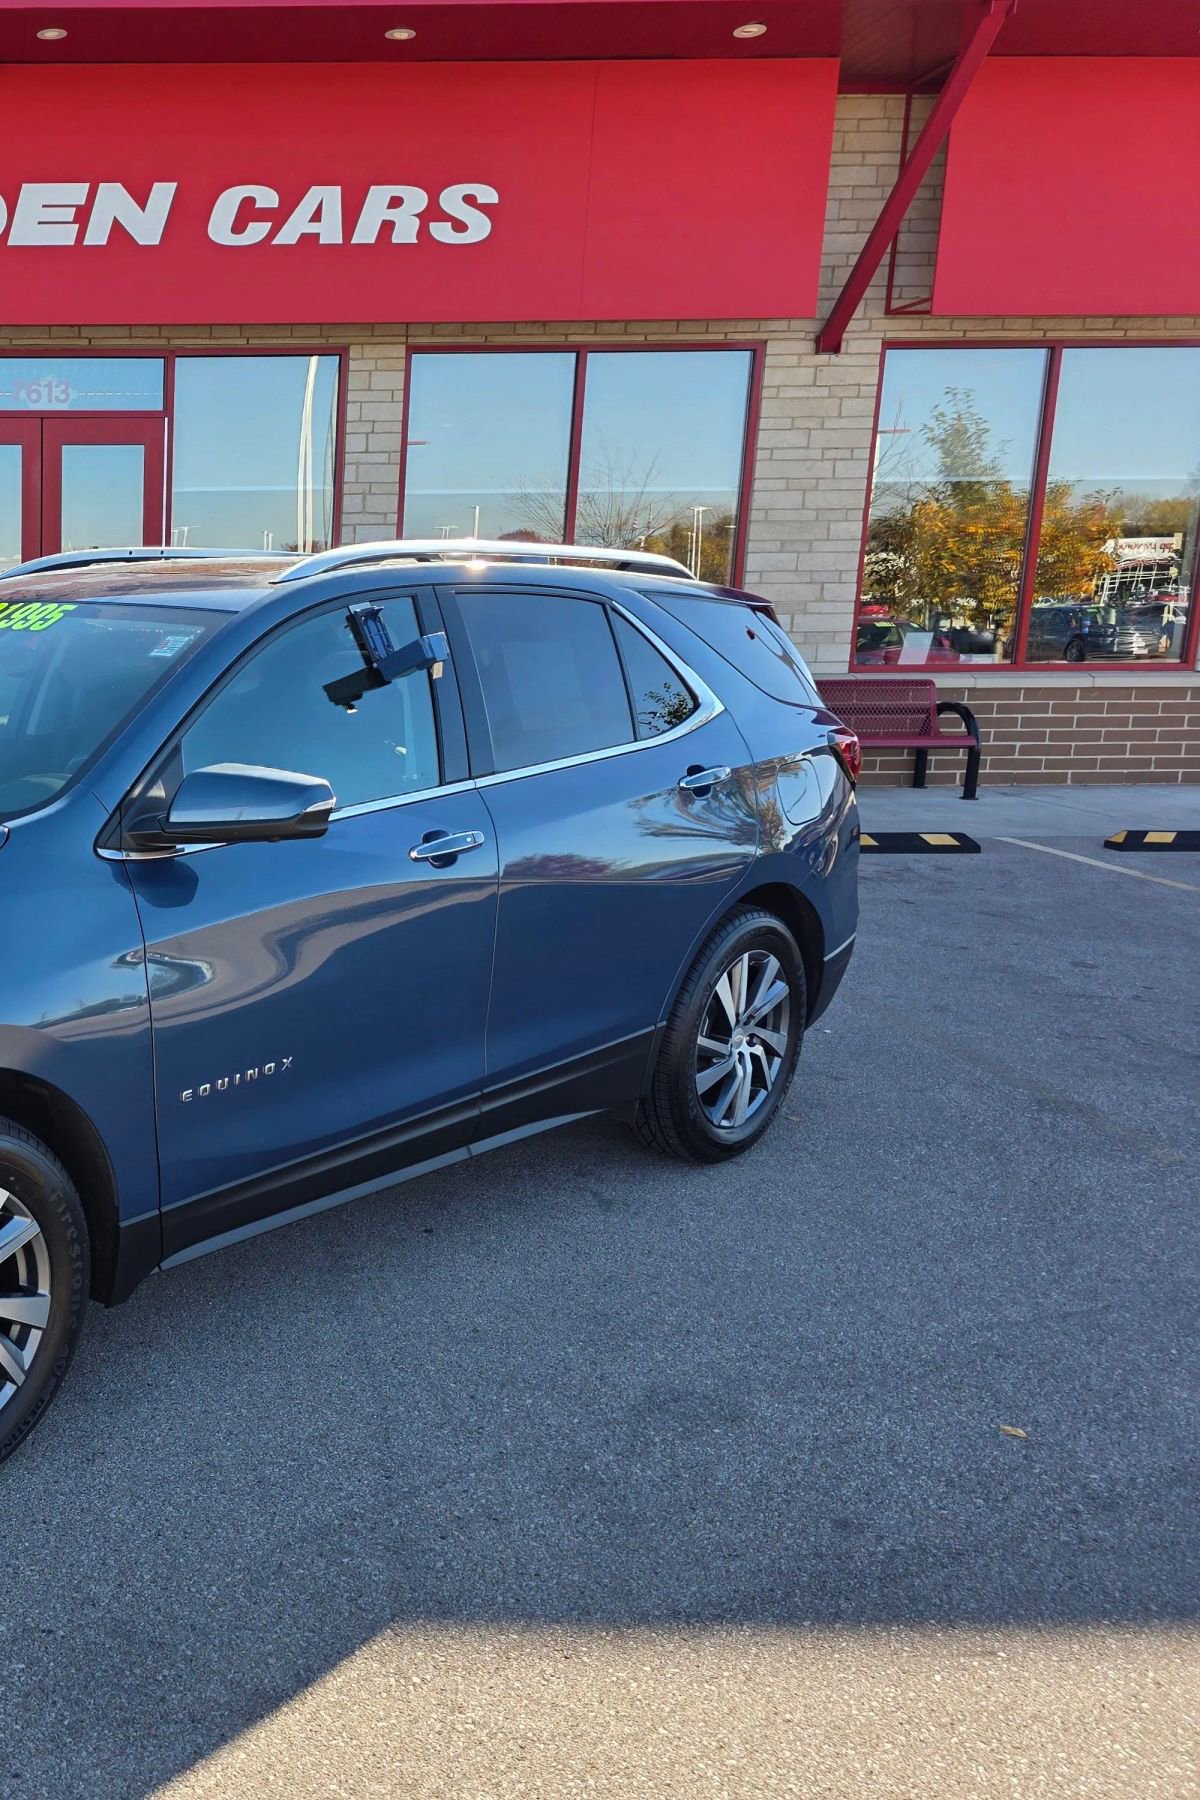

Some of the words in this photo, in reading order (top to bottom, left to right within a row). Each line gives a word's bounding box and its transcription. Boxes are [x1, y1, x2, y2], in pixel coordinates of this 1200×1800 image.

[208, 184, 498, 245] CARS
[11, 379, 71, 404] 7613
[180, 1056, 293, 1102] EQUINOX
